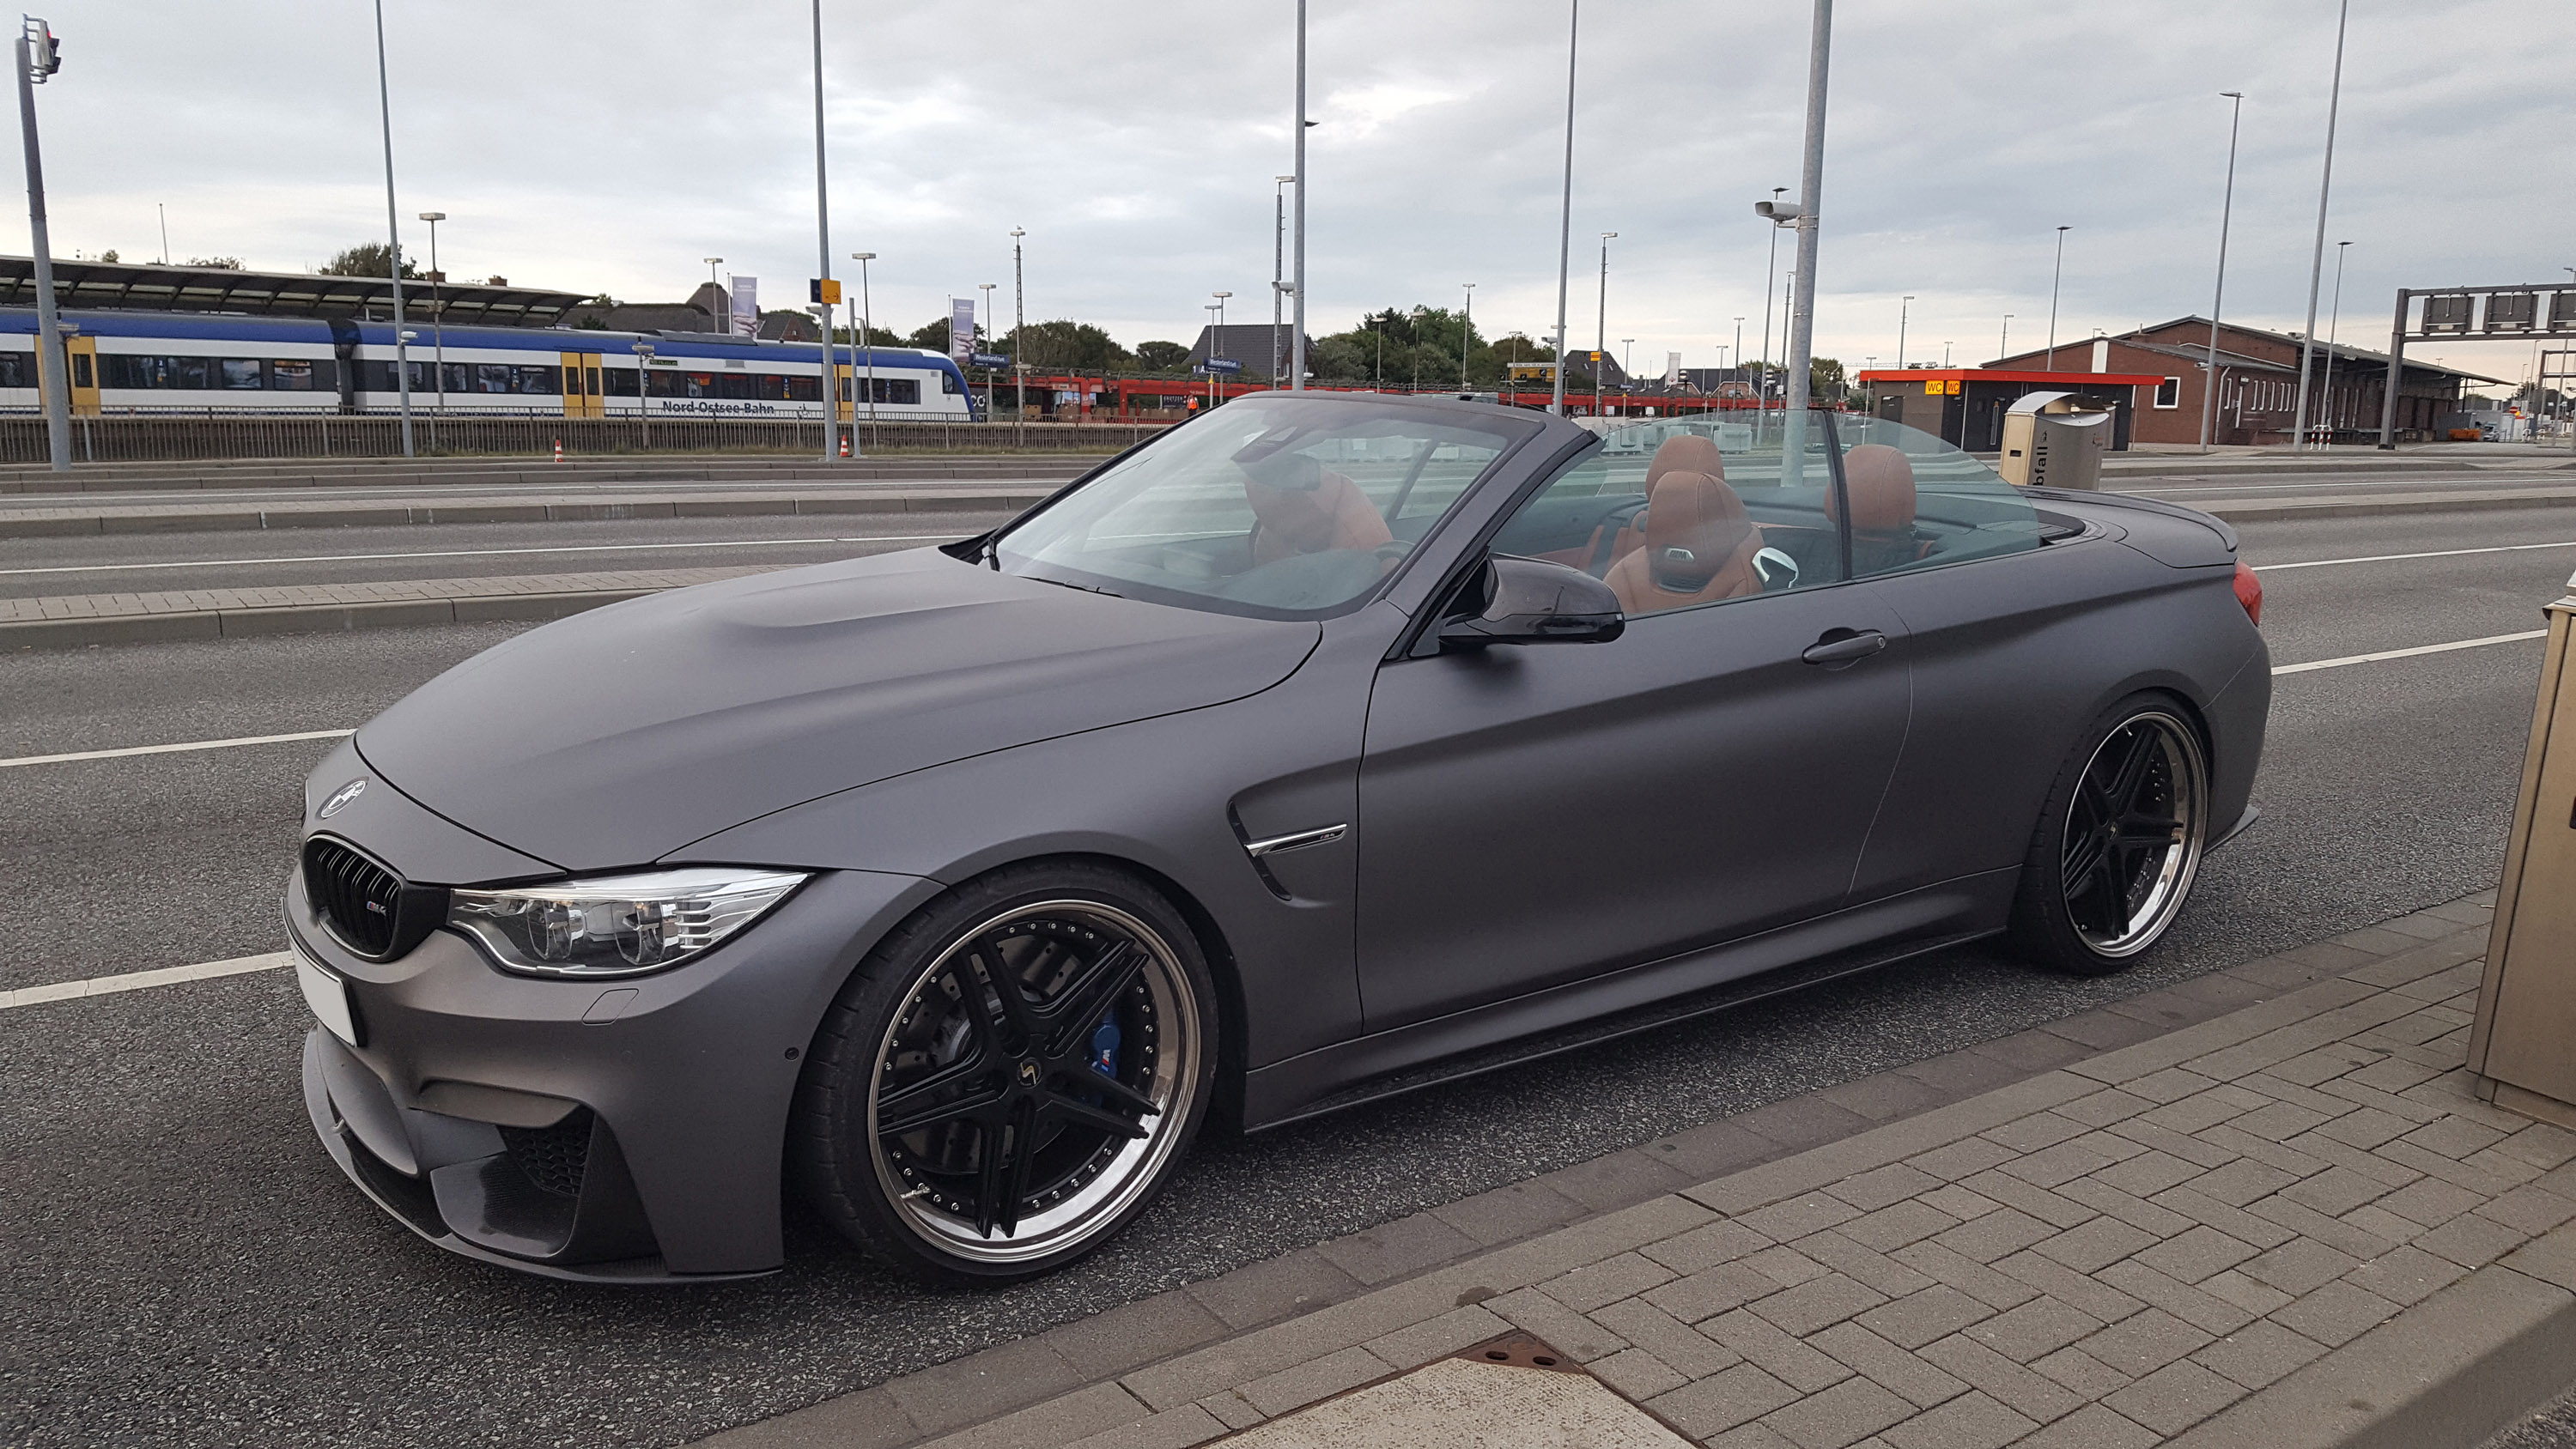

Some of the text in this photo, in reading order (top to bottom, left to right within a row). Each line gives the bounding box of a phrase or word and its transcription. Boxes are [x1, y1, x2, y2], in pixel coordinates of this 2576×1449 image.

[1927, 382, 1942, 392] WC
[1947, 382, 1959, 392] WC
[662, 401, 775, 415] Nord-Ostsee-Bahn
[2032, 446, 2048, 486] bfall
